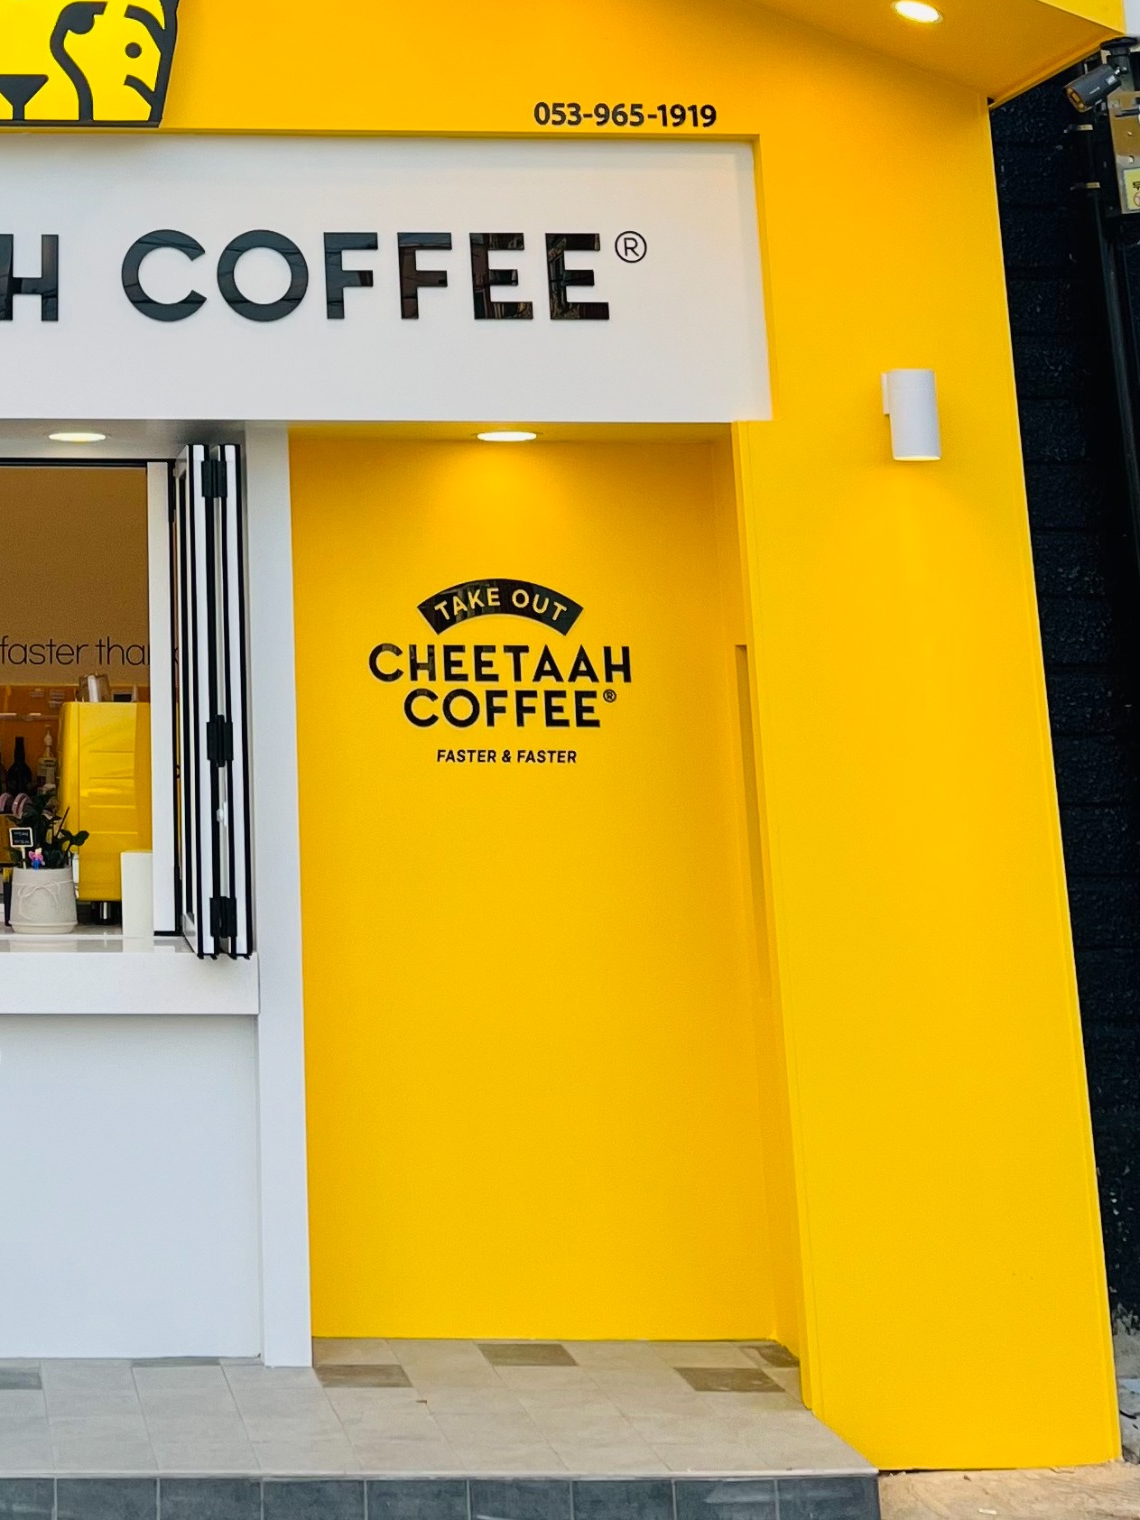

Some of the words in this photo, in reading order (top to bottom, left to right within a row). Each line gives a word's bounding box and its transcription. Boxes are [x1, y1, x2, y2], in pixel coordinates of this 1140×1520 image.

[533, 102, 717, 127] 053-965-1919
[434, 587, 500, 621] TAKE
[511, 589, 567, 621] OUT
[94, 636, 150, 666] tha
[368, 643, 632, 683] CHEETAAH
[437, 749, 497, 763] FASTER
[501, 750, 512, 763] &
[517, 750, 577, 764] FASTER
